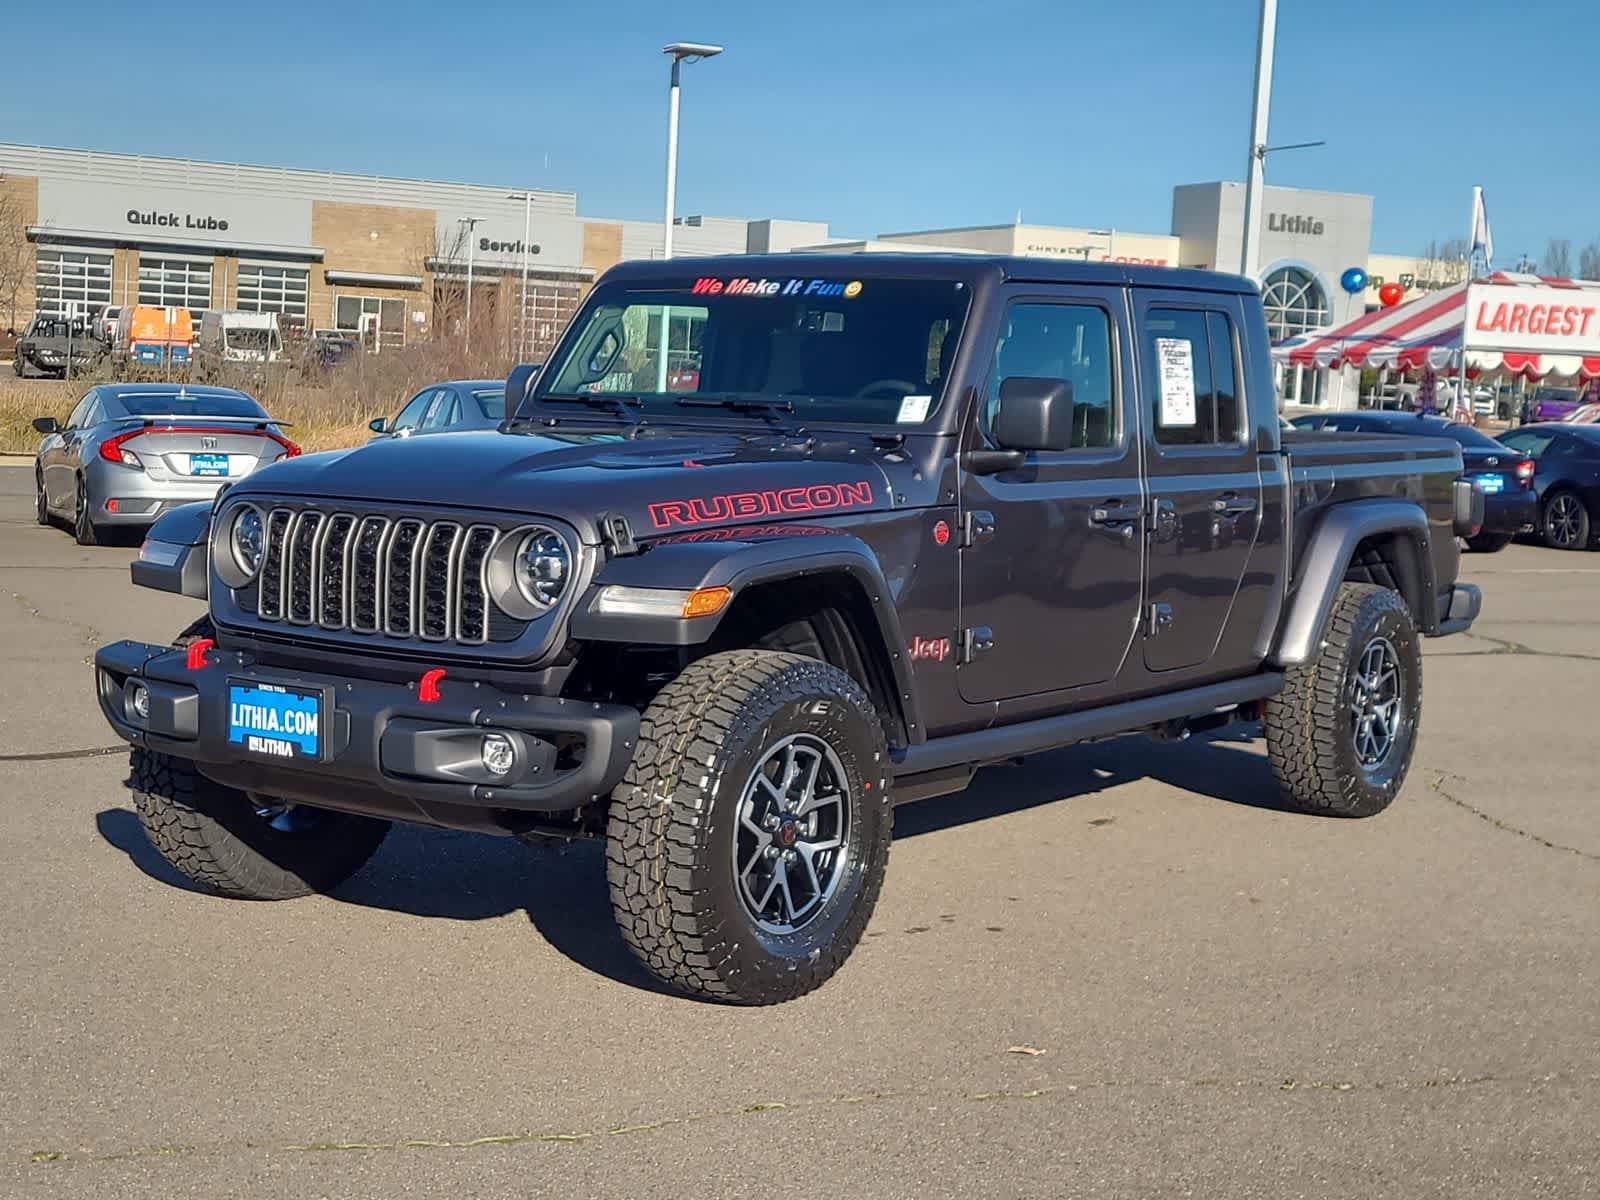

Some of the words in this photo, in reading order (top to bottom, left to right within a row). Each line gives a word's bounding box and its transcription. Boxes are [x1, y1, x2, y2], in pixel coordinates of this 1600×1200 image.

[126, 209, 180, 228] Quick
[185, 214, 229, 231] Lube
[1268, 213, 1324, 235] Lithia
[479, 238, 541, 255] Service
[691, 278, 724, 295] We
[724, 278, 781, 295] Make
[782, 279, 804, 295] It
[803, 280, 846, 296] Fun
[1475, 301, 1597, 337] LARGEST
[648, 480, 874, 529] RUBICON
[909, 635, 951, 662] Jeep
[231, 703, 319, 737] LITHIA.COM
[259, 737, 294, 758] LITHIA
